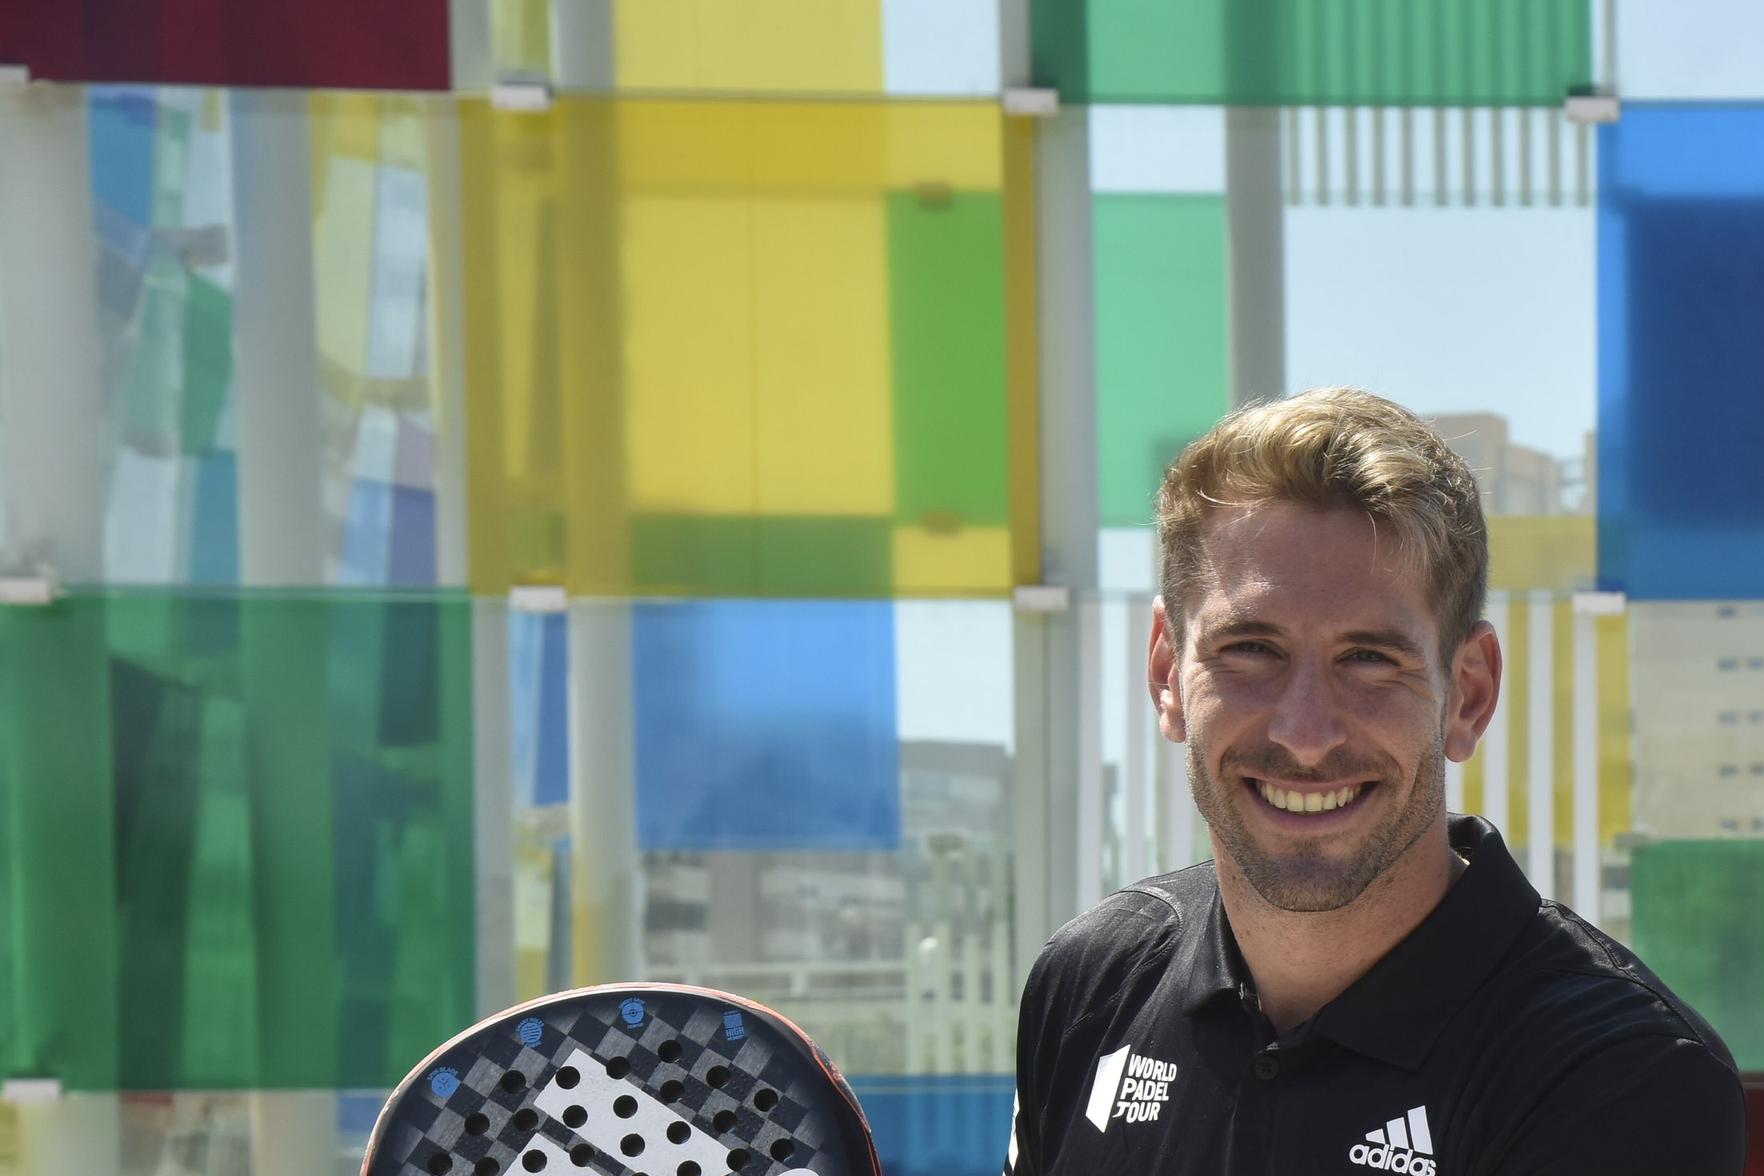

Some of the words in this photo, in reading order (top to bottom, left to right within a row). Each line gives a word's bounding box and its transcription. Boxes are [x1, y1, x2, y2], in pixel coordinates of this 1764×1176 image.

[1128, 1053, 1177, 1082] WORLD
[1120, 1077, 1169, 1101] PADEL
[1112, 1101, 1161, 1123] TOUR
